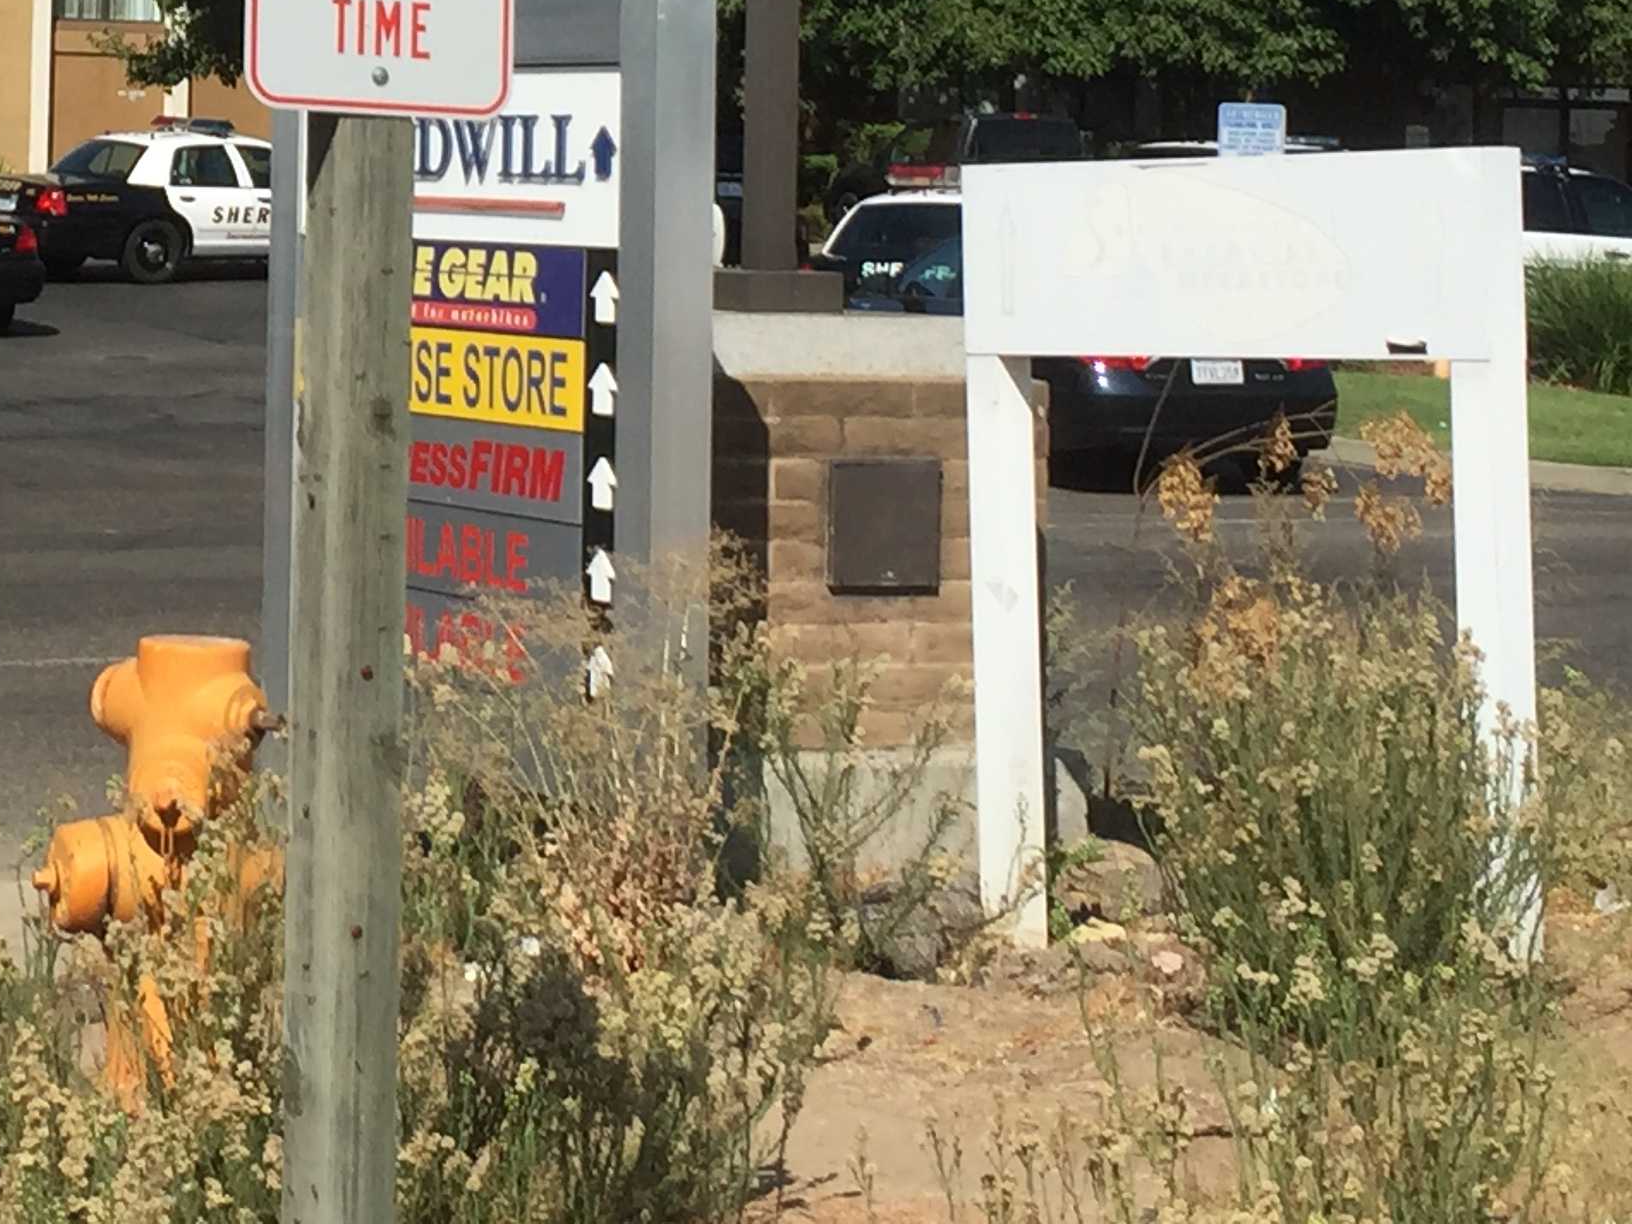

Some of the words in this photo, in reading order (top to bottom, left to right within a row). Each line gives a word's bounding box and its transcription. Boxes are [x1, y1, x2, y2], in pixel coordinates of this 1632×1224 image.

[415, 114, 586, 185] DWILL
[413, 246, 435, 296] E
[438, 247, 538, 304] GEAR
[423, 302, 444, 319] for
[415, 339, 452, 405] SE
[463, 343, 568, 416] STORE
[409, 439, 566, 503] ESSFIRM
